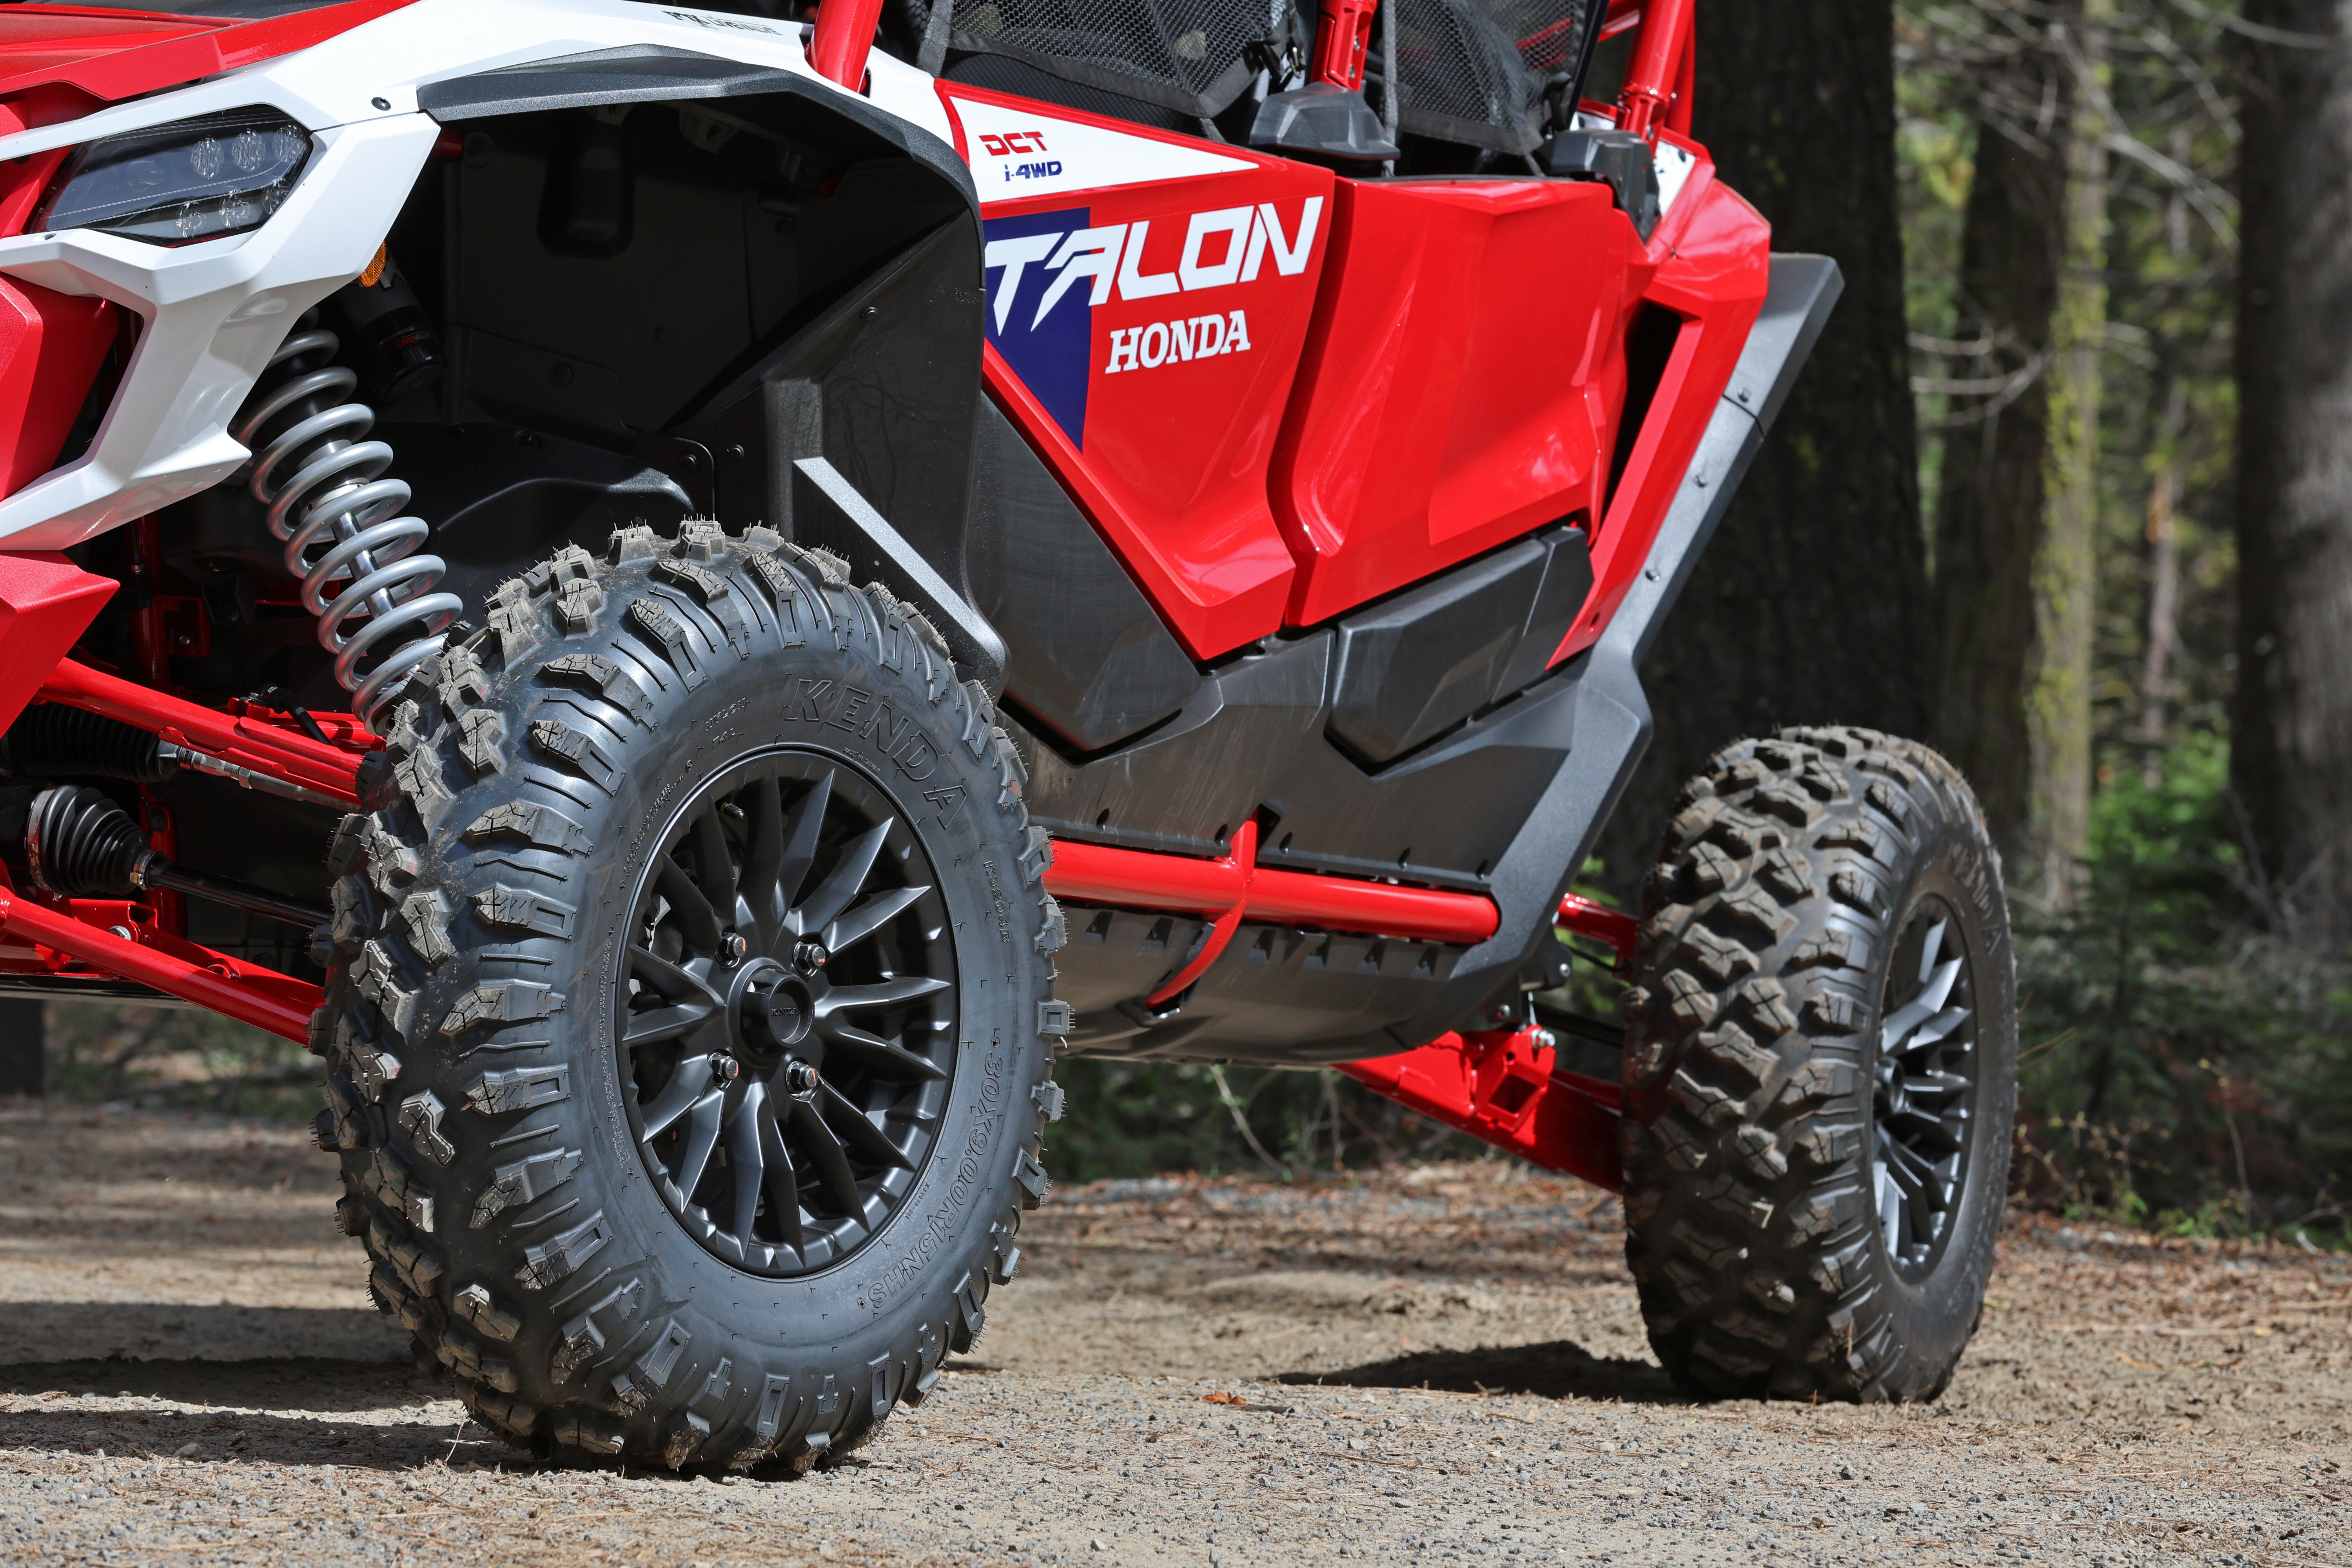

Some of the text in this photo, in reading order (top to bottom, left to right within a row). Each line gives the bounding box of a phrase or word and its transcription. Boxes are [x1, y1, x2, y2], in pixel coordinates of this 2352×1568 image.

[979, 131, 1048, 156] DCT
[1004, 161, 1062, 181] i-4WD
[985, 196, 1324, 336] TALON
[1105, 310, 1250, 374] HONDA
[706, 697, 746, 732] NYLON
[784, 679, 967, 830] KENDA
[984, 860, 1010, 942] K3204B
